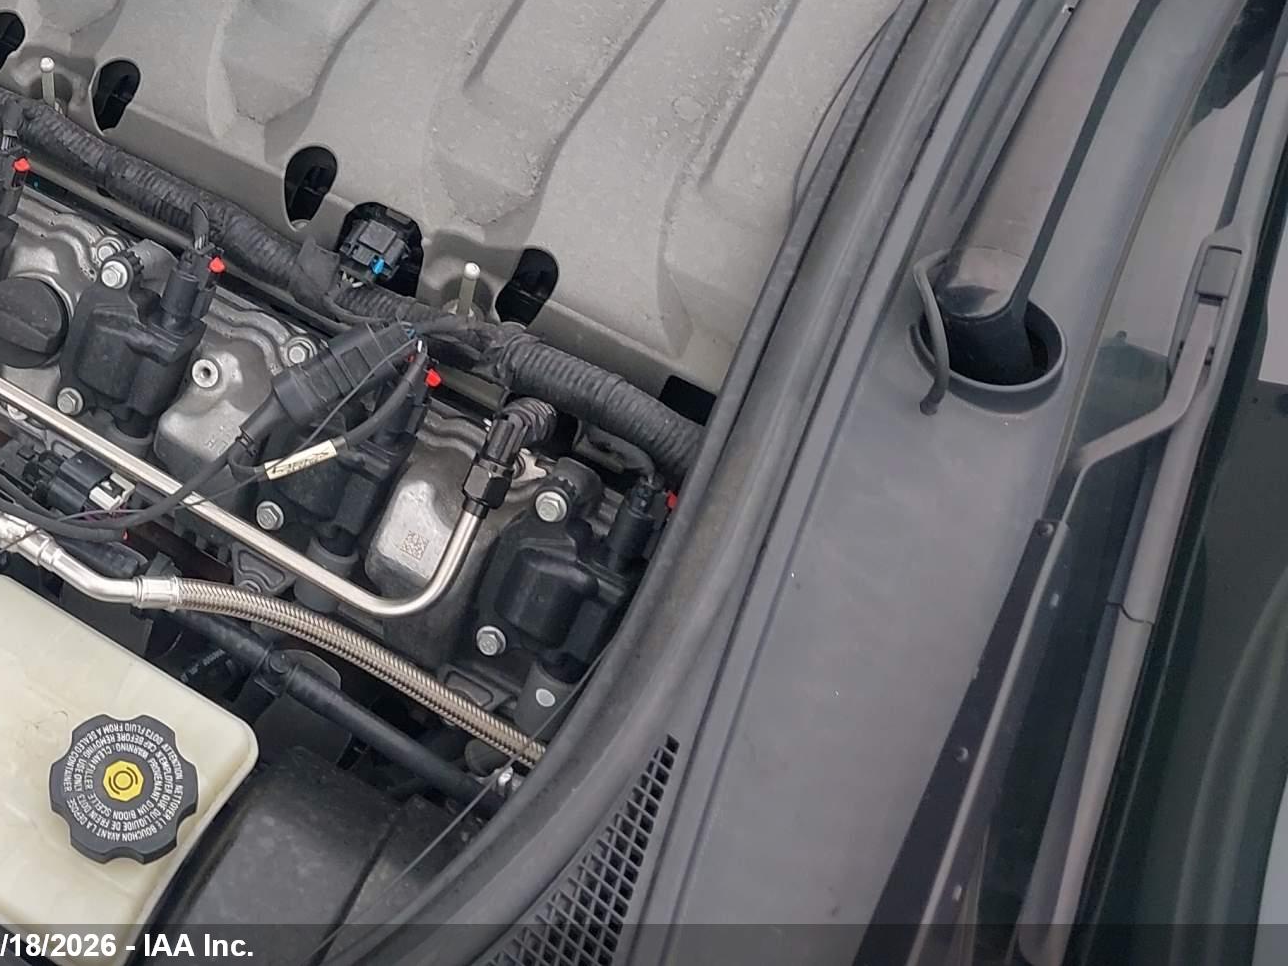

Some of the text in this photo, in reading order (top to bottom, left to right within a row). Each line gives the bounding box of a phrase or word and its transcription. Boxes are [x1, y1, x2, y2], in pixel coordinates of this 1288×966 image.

[95, 727, 102, 737] A
[102, 722, 123, 735] FROM
[124, 722, 146, 735] FLUID
[144, 728, 164, 745] DOT3
[73, 730, 98, 753] SEALED
[115, 732, 144, 745] BEFORE
[142, 740, 157, 753] CAP
[90, 745, 112, 765] CLEAN
[74, 757, 87, 773] USE
[73, 773, 83, 792] ONLY
[83, 762, 96, 790] FILLER
[76, 793, 92, 814] DOT3
[157, 793, 171, 811] QUE
[162, 784, 184, 821] NETTOYER
[87, 809, 110, 828] FREIN
[112, 809, 137, 821] BIDON
[149, 807, 161, 820] DU
[86, 820, 97, 833] LA
[110, 820, 121, 831] DE
[122, 814, 152, 831] LIQUIDE
[154, 817, 167, 830] LE
[95, 827, 121, 842] AVANT
[121, 823, 157, 842] BOUCHON
